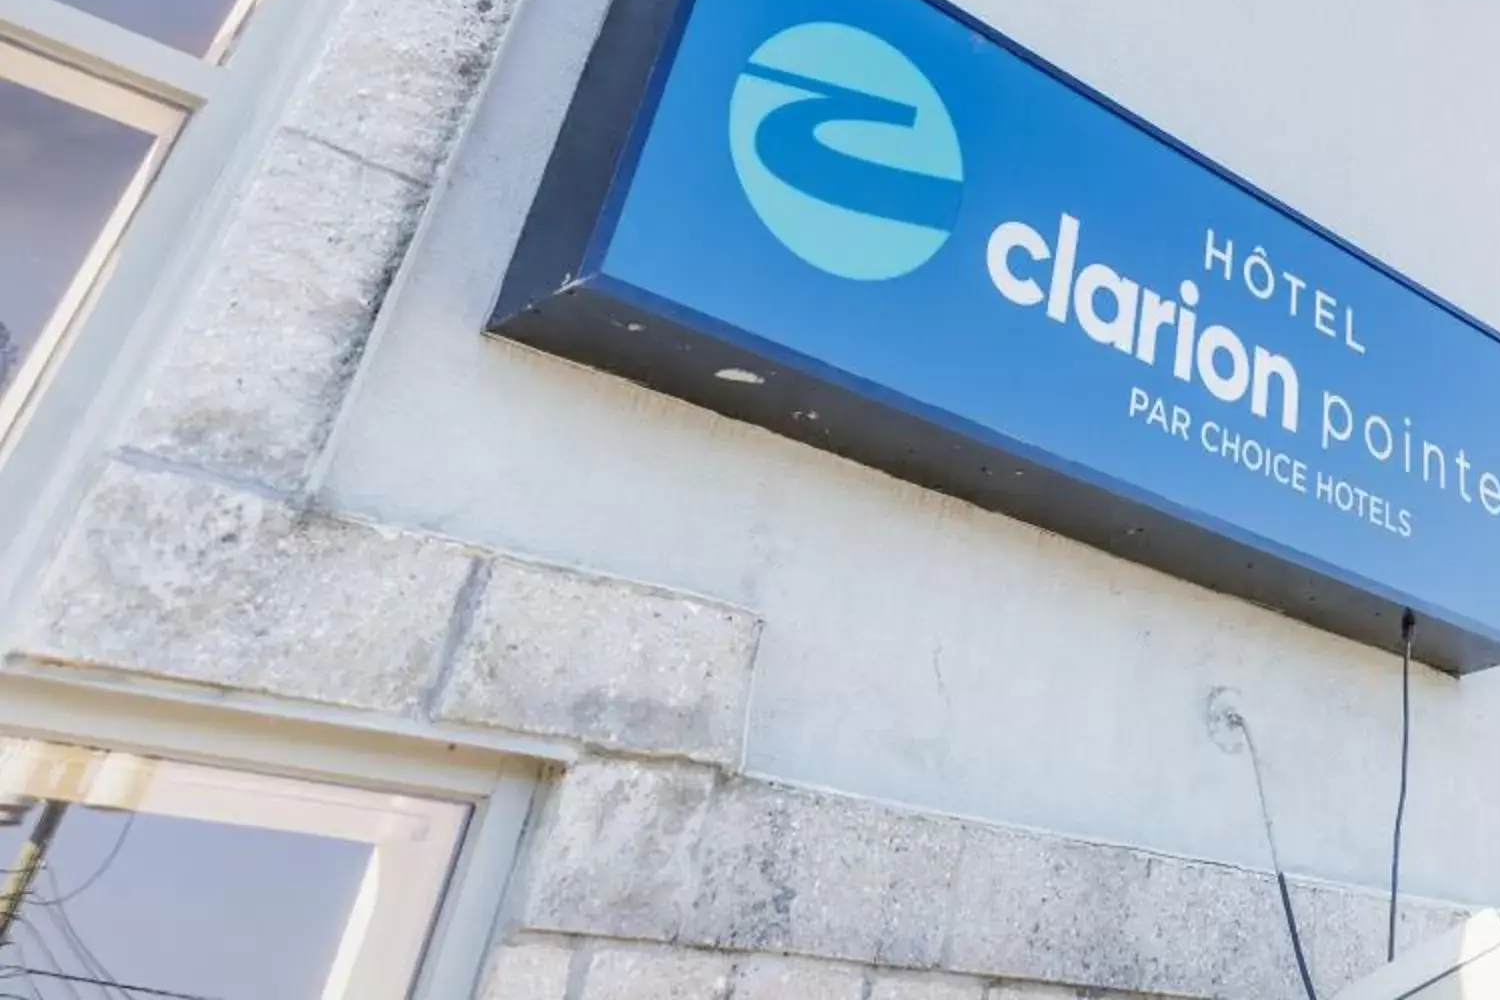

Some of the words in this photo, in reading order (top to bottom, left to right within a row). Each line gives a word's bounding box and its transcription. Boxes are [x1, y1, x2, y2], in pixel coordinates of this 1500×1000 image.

[986, 213, 1299, 433] clarion
[1203, 229, 1366, 354] HÔTEL
[1129, 387, 1191, 440] PAR
[1201, 421, 1307, 493] CHOICE
[1316, 471, 1412, 537] HOTELS
